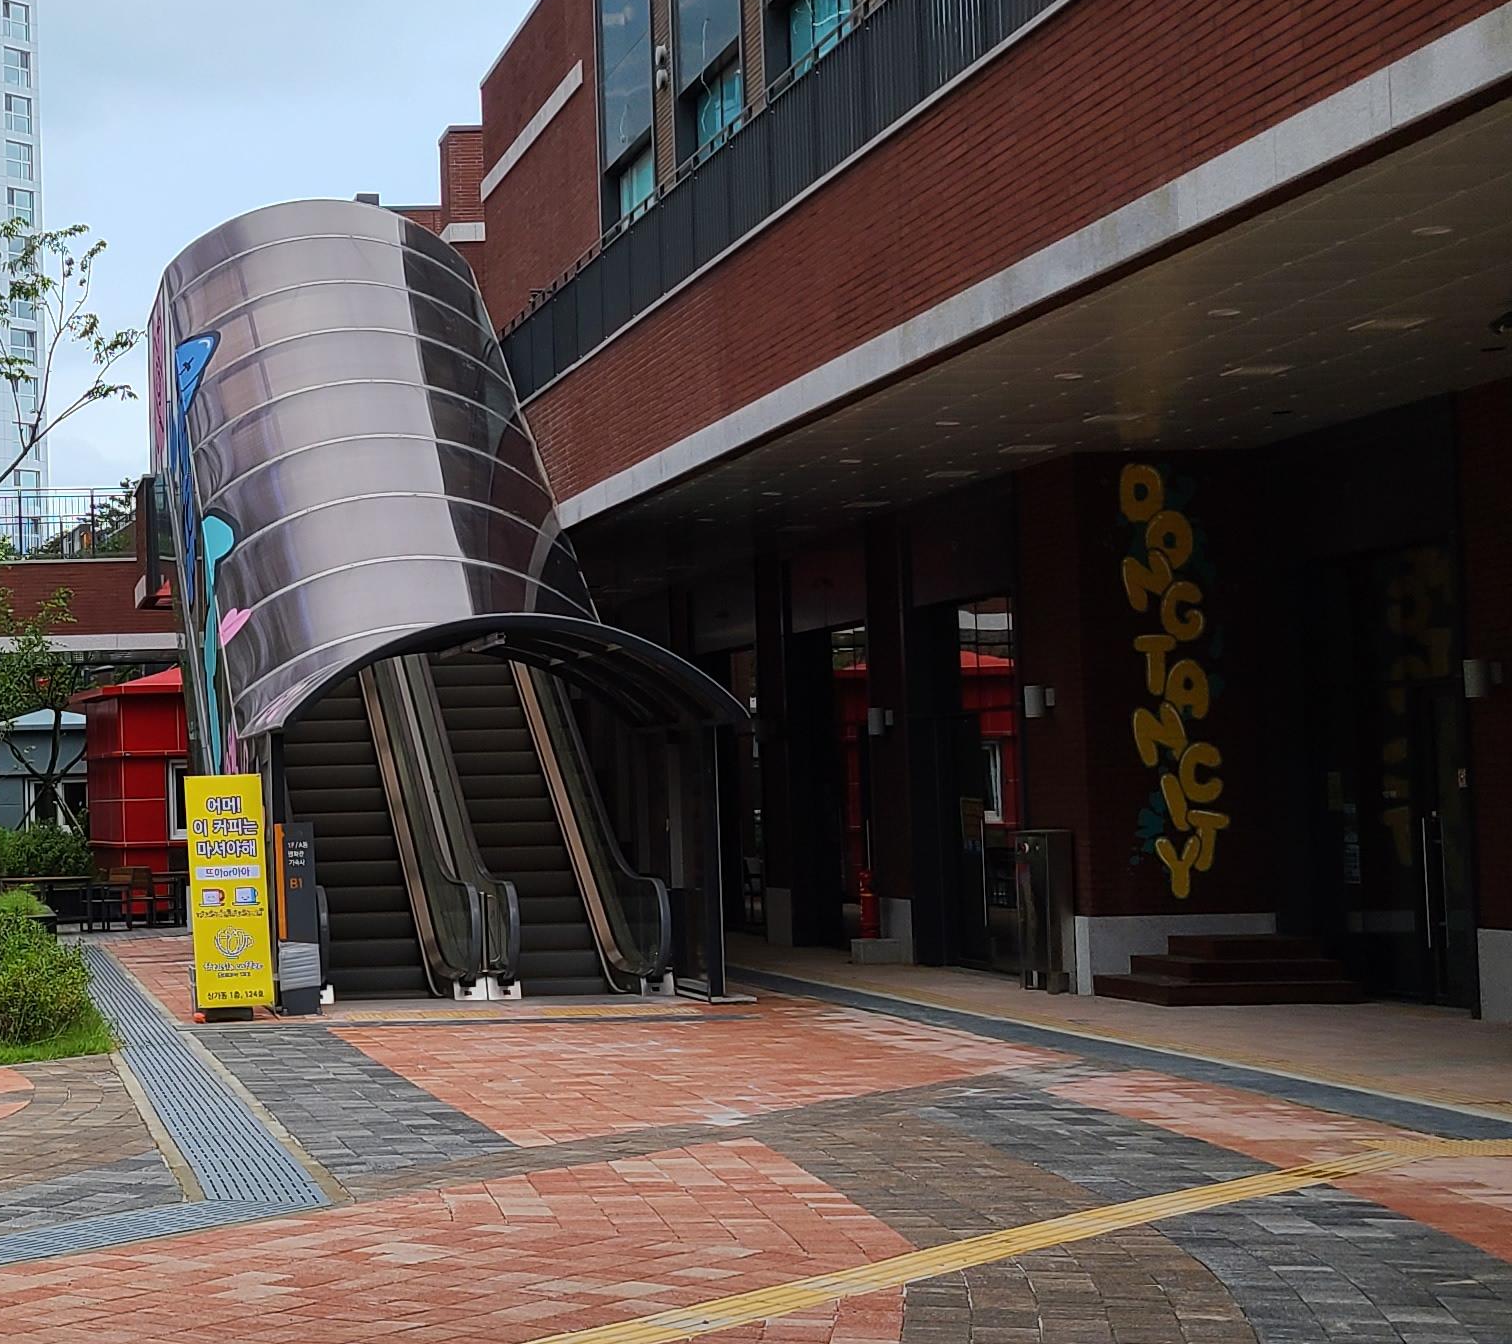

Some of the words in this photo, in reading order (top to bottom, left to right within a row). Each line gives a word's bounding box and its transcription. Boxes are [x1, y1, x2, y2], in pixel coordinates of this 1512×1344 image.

[206, 797, 241, 815] 어머!
[193, 820, 208, 837] 이
[212, 818, 259, 836] 커피는
[196, 839, 257, 858] 마셔야해
[289, 877, 303, 890] B1
